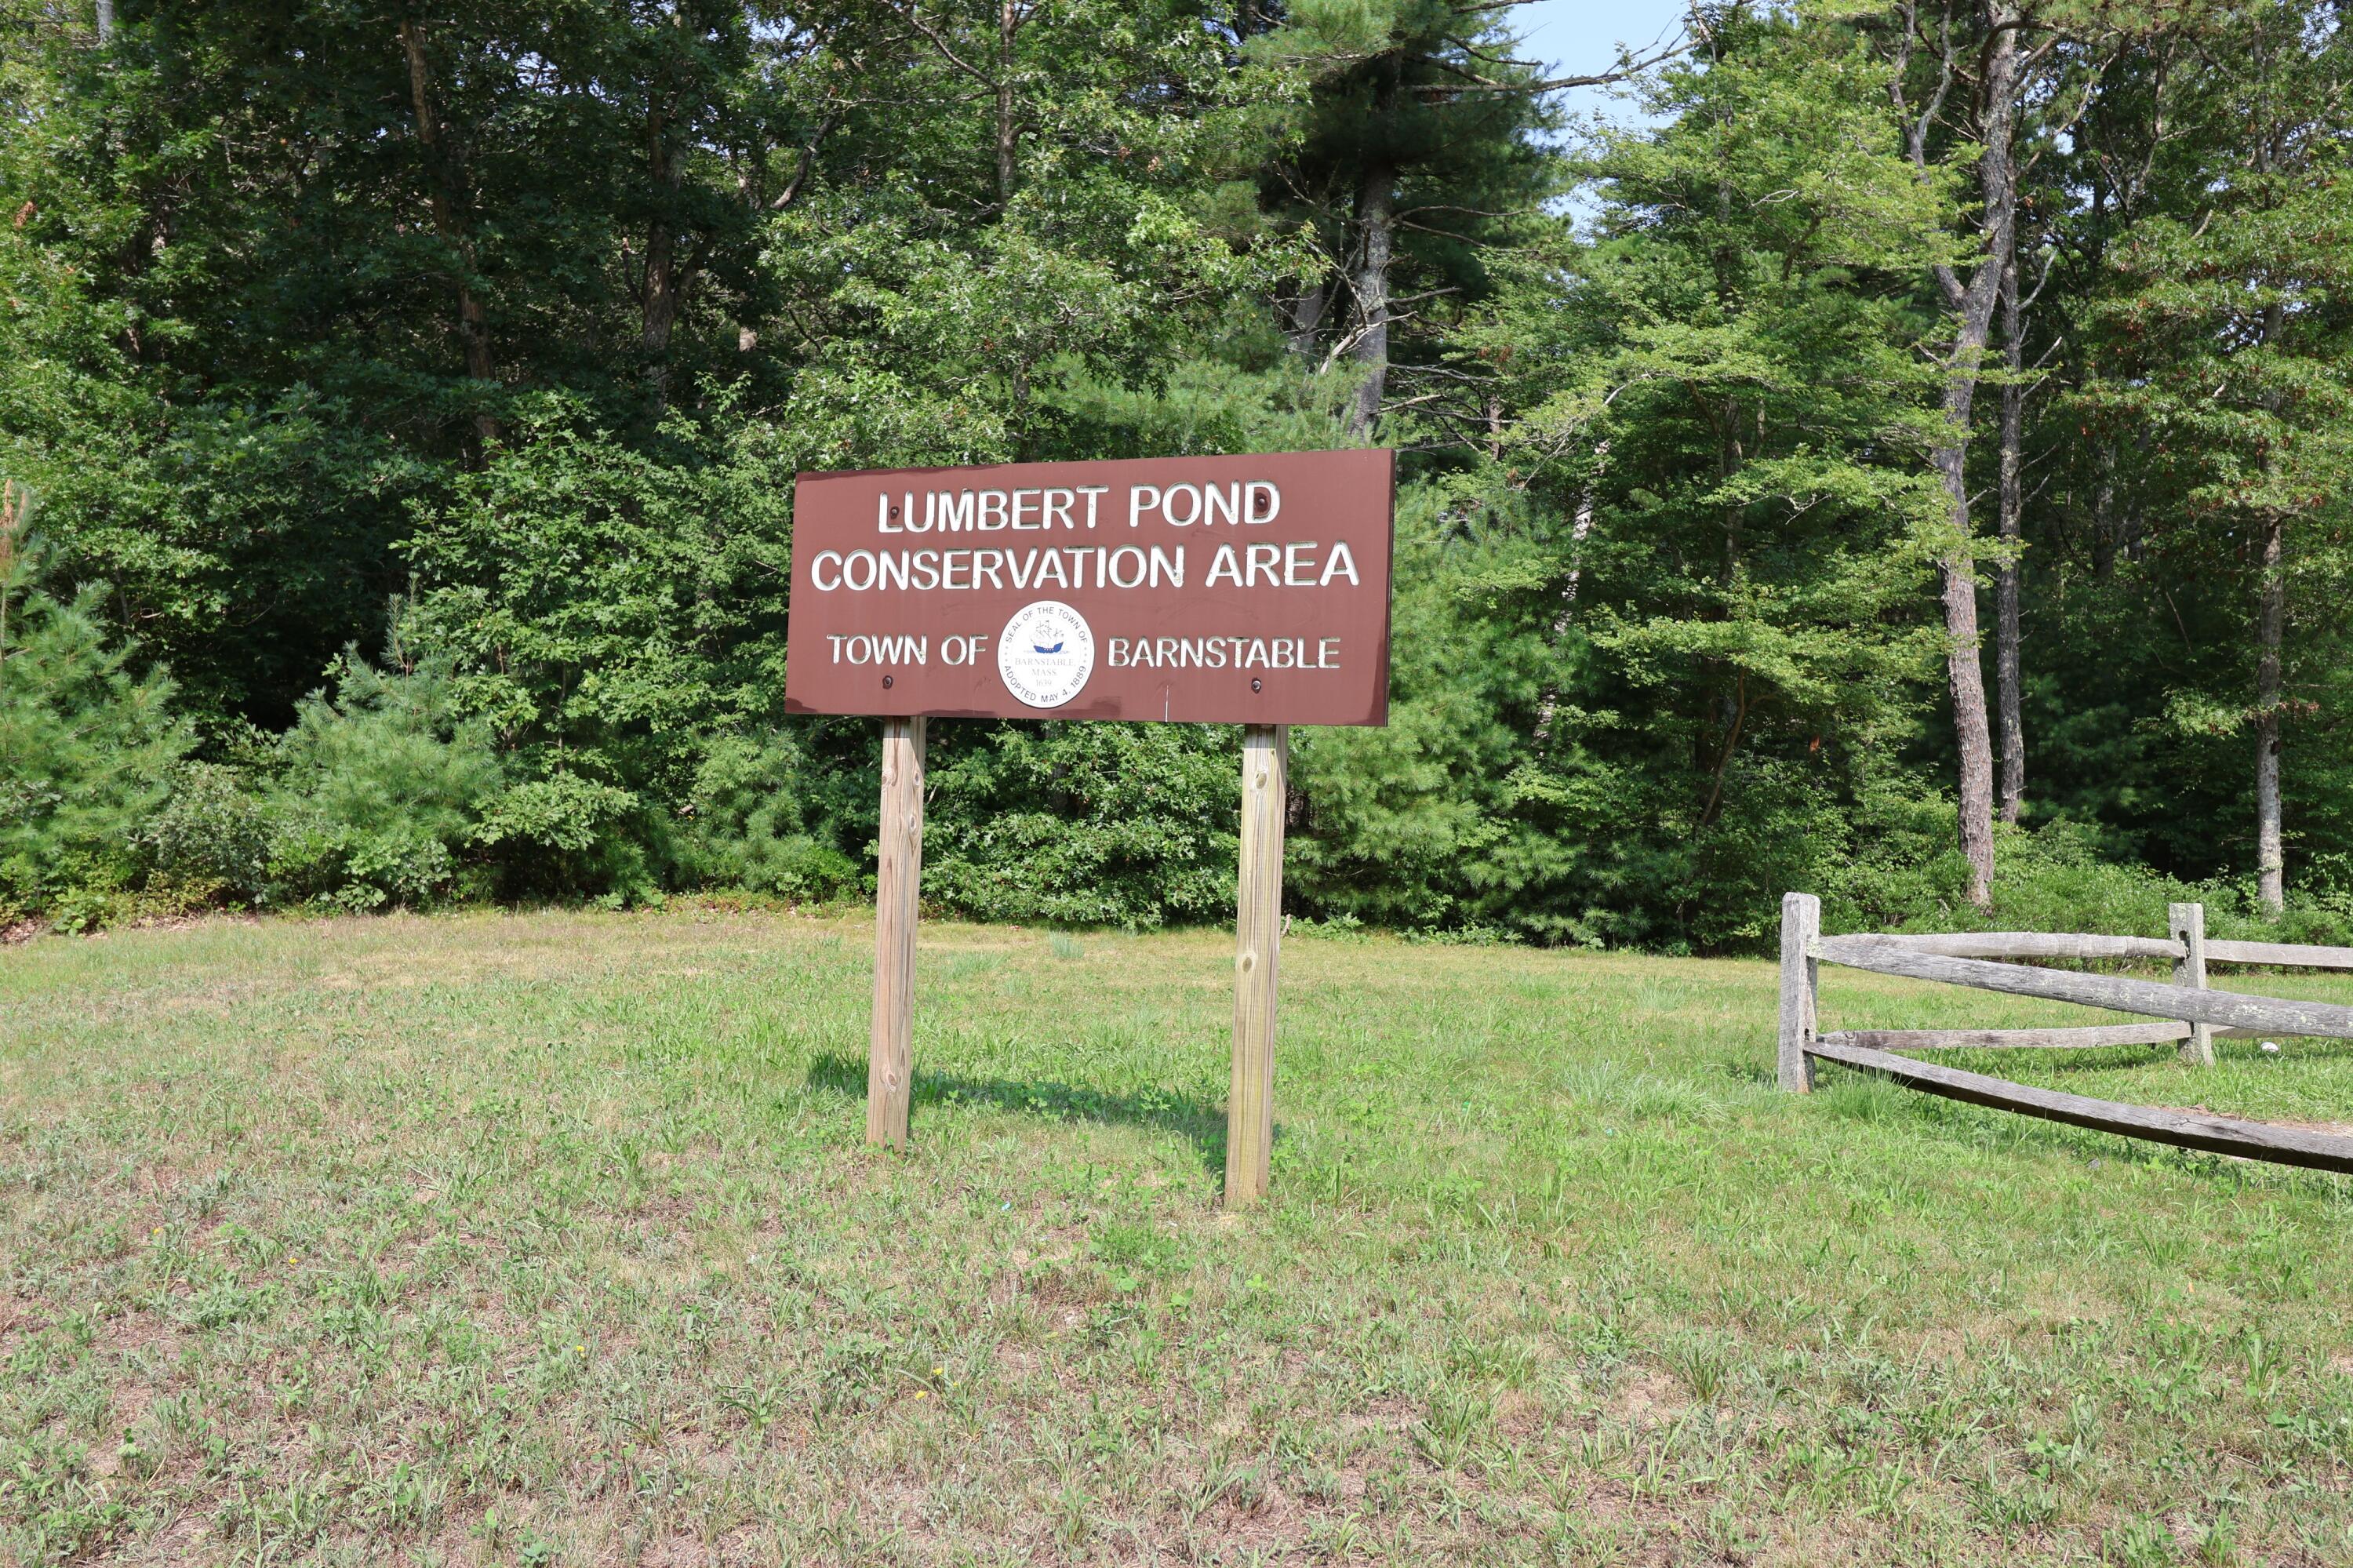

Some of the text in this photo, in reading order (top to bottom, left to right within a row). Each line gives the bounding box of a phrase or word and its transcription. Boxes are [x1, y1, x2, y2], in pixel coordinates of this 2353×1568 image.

[878, 479, 1281, 534] LUMBERT POND
[811, 540, 1360, 592] CONSERVATION AREA
[1006, 606, 1088, 644] SEAL OF THE TOWN OF
[826, 633, 1342, 670] TOWN OF BARNSTABLE
[1004, 665, 1037, 701] ADOPTED
[1041, 693, 1059, 703] MAY
[1071, 665, 1087, 688] 1889
